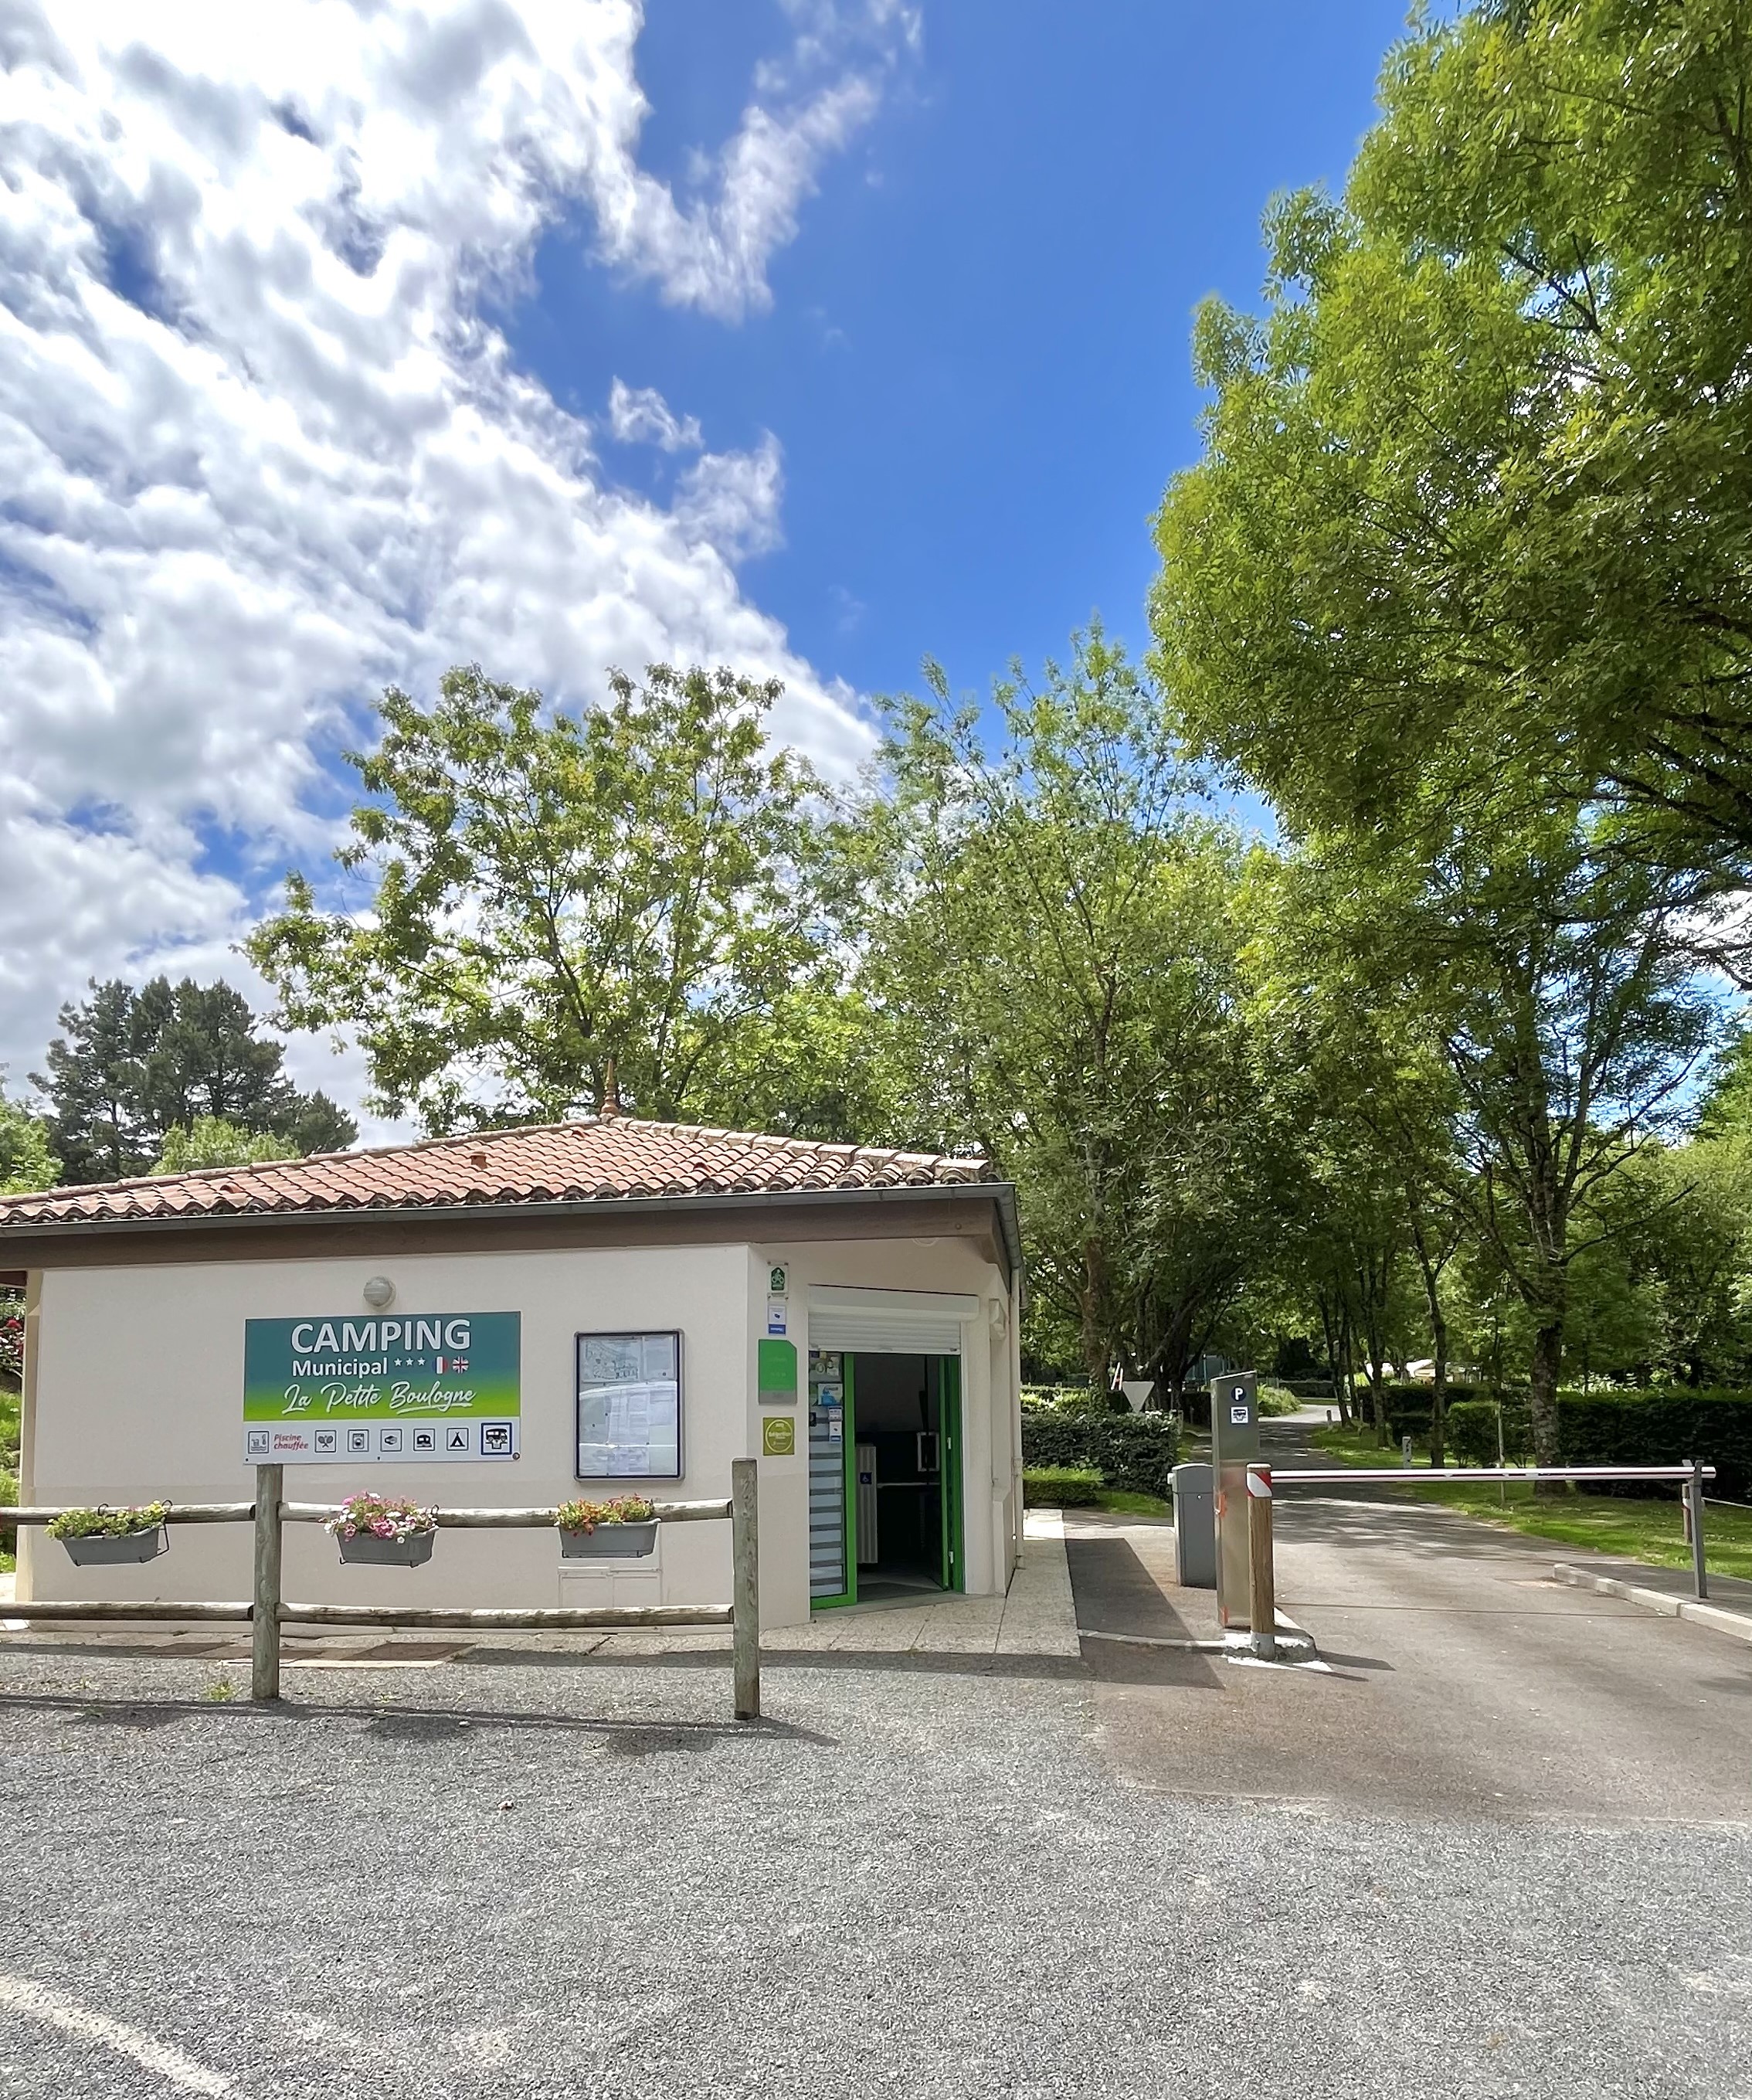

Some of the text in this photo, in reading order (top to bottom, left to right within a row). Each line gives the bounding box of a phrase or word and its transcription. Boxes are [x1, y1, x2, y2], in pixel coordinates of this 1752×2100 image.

[290, 1319, 471, 1353] CAMPING
[292, 1358, 388, 1378] Municipal
[282, 1381, 477, 1415] La Petite Boulogne
[1235, 1388, 1243, 1400] P
